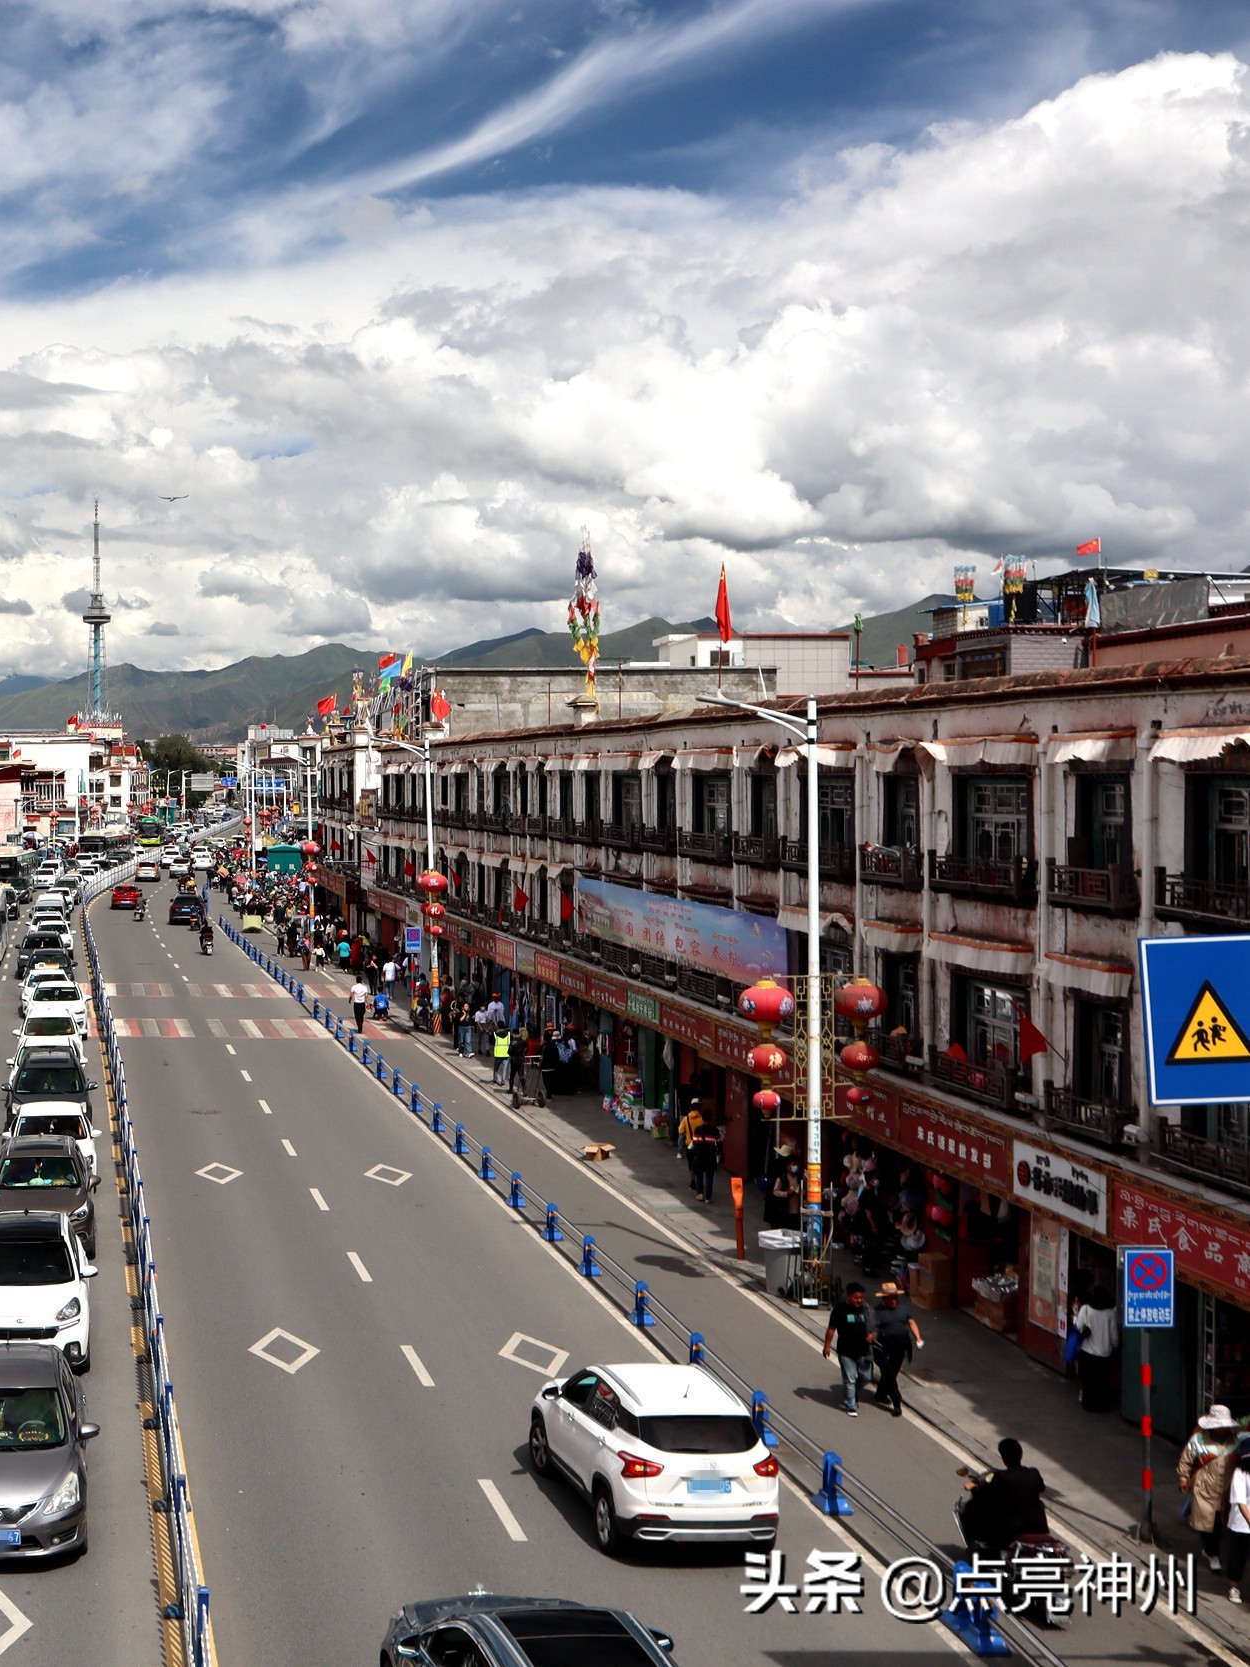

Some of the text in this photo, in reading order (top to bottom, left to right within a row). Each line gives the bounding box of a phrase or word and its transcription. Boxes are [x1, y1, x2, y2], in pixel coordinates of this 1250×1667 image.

[642, 927, 666, 948] 团结
[674, 935, 703, 957] 包容
[1127, 1307, 1171, 1323] 禁止停放电动车
